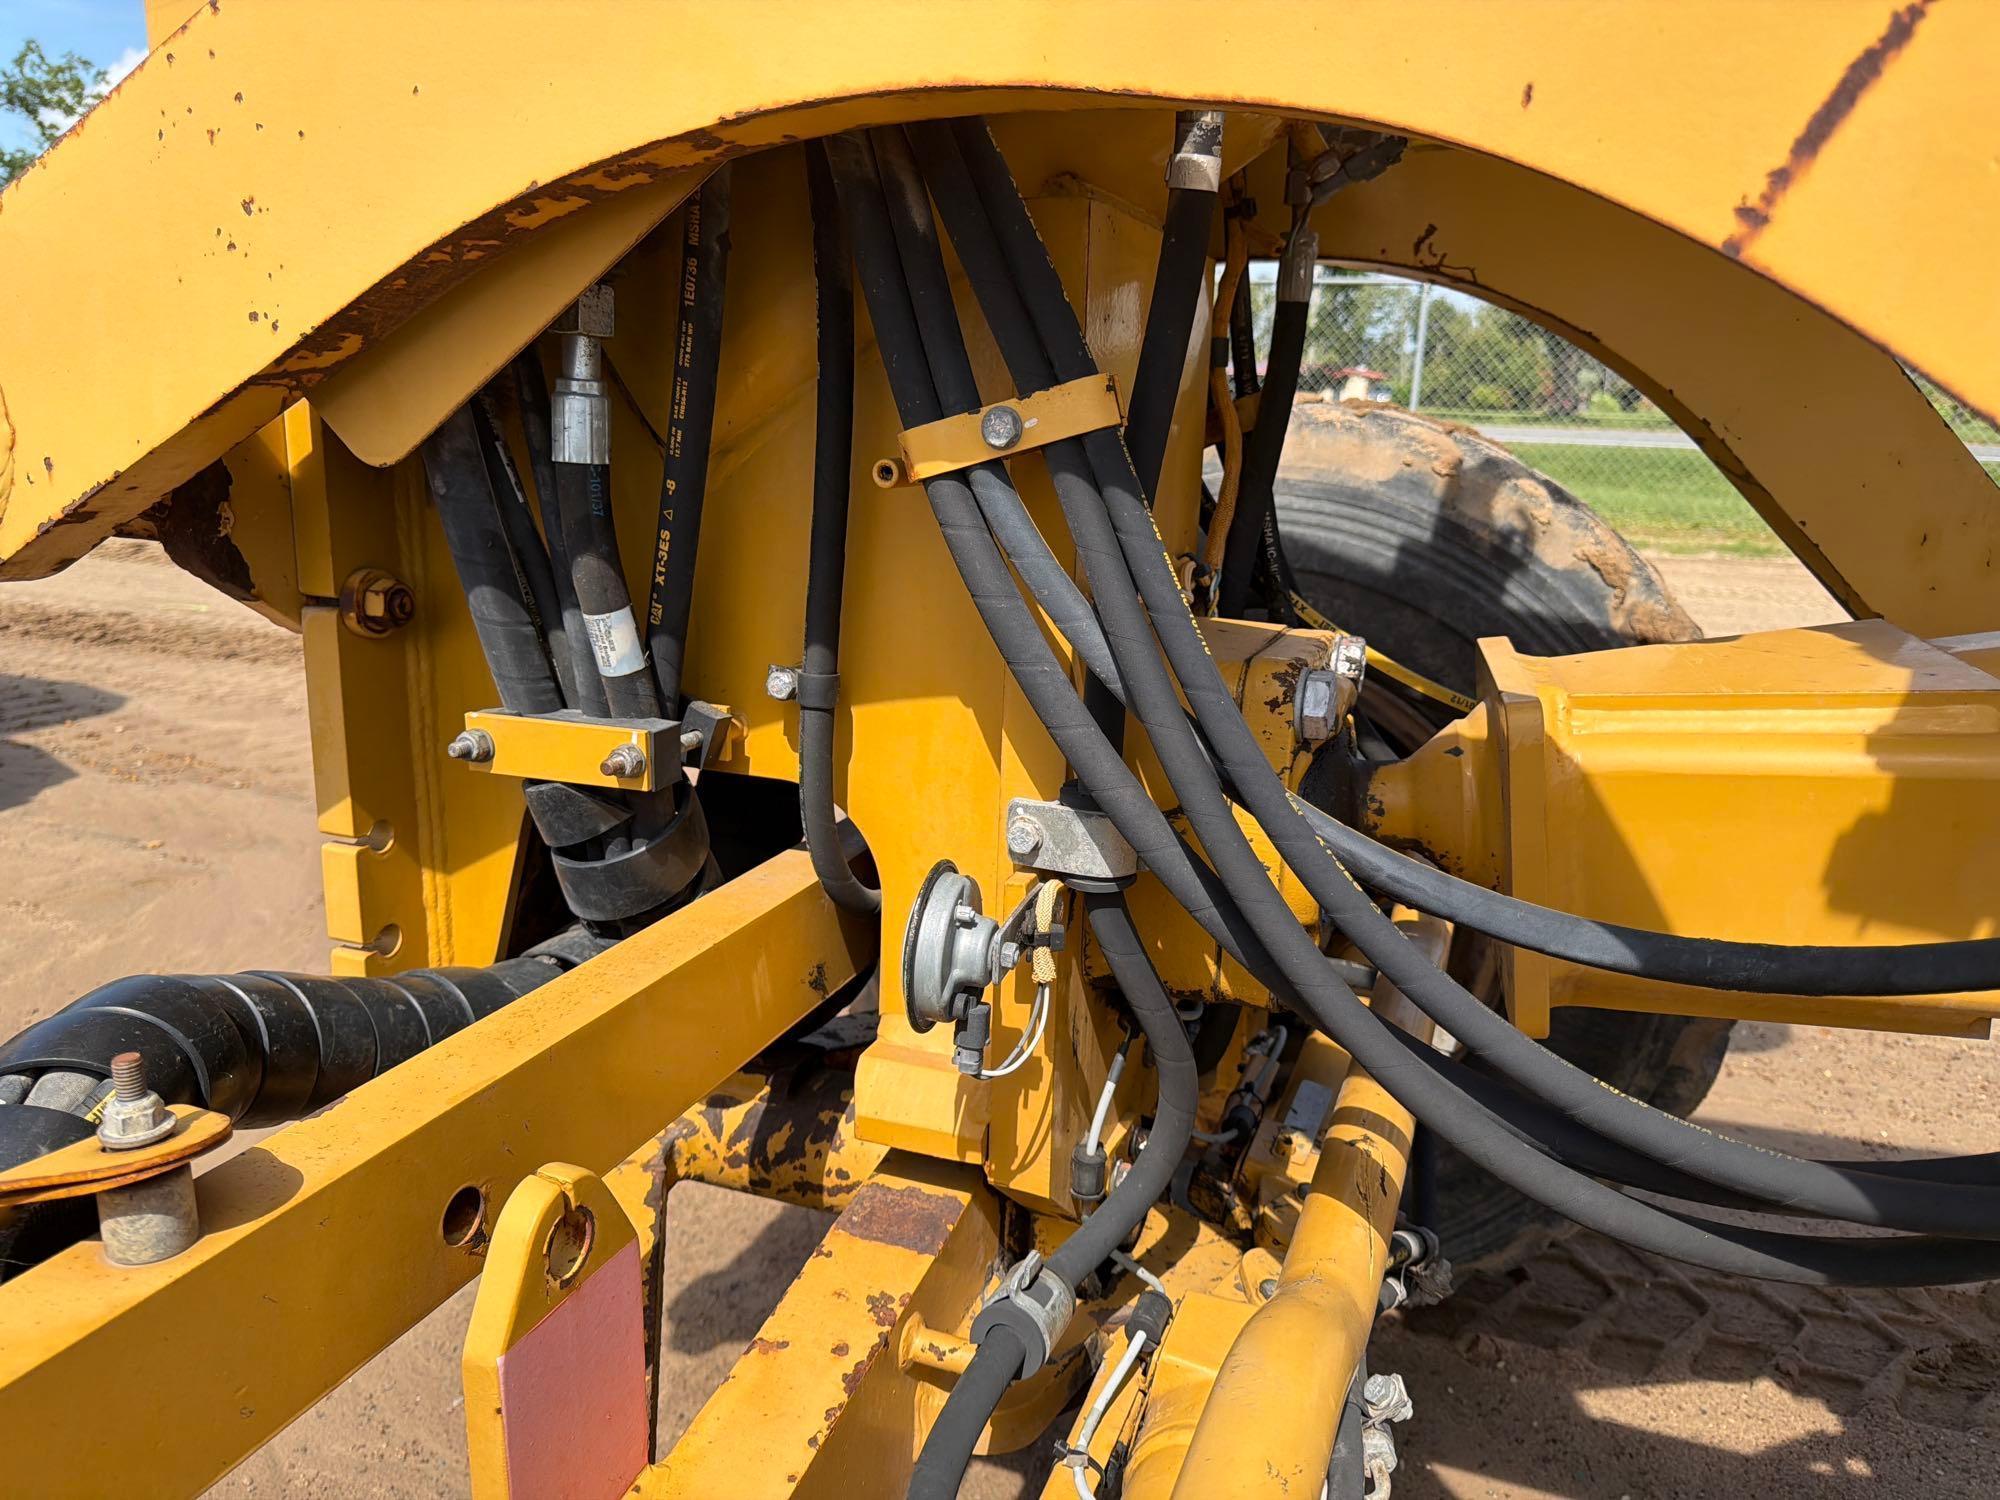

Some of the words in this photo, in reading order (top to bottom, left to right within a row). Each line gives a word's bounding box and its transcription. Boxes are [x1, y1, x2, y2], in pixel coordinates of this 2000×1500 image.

[687, 204, 699, 245] MSHA
[684, 256, 697, 307] 1E0736
[655, 528, 670, 585] XT-3ES
[664, 479, 676, 495] -8
